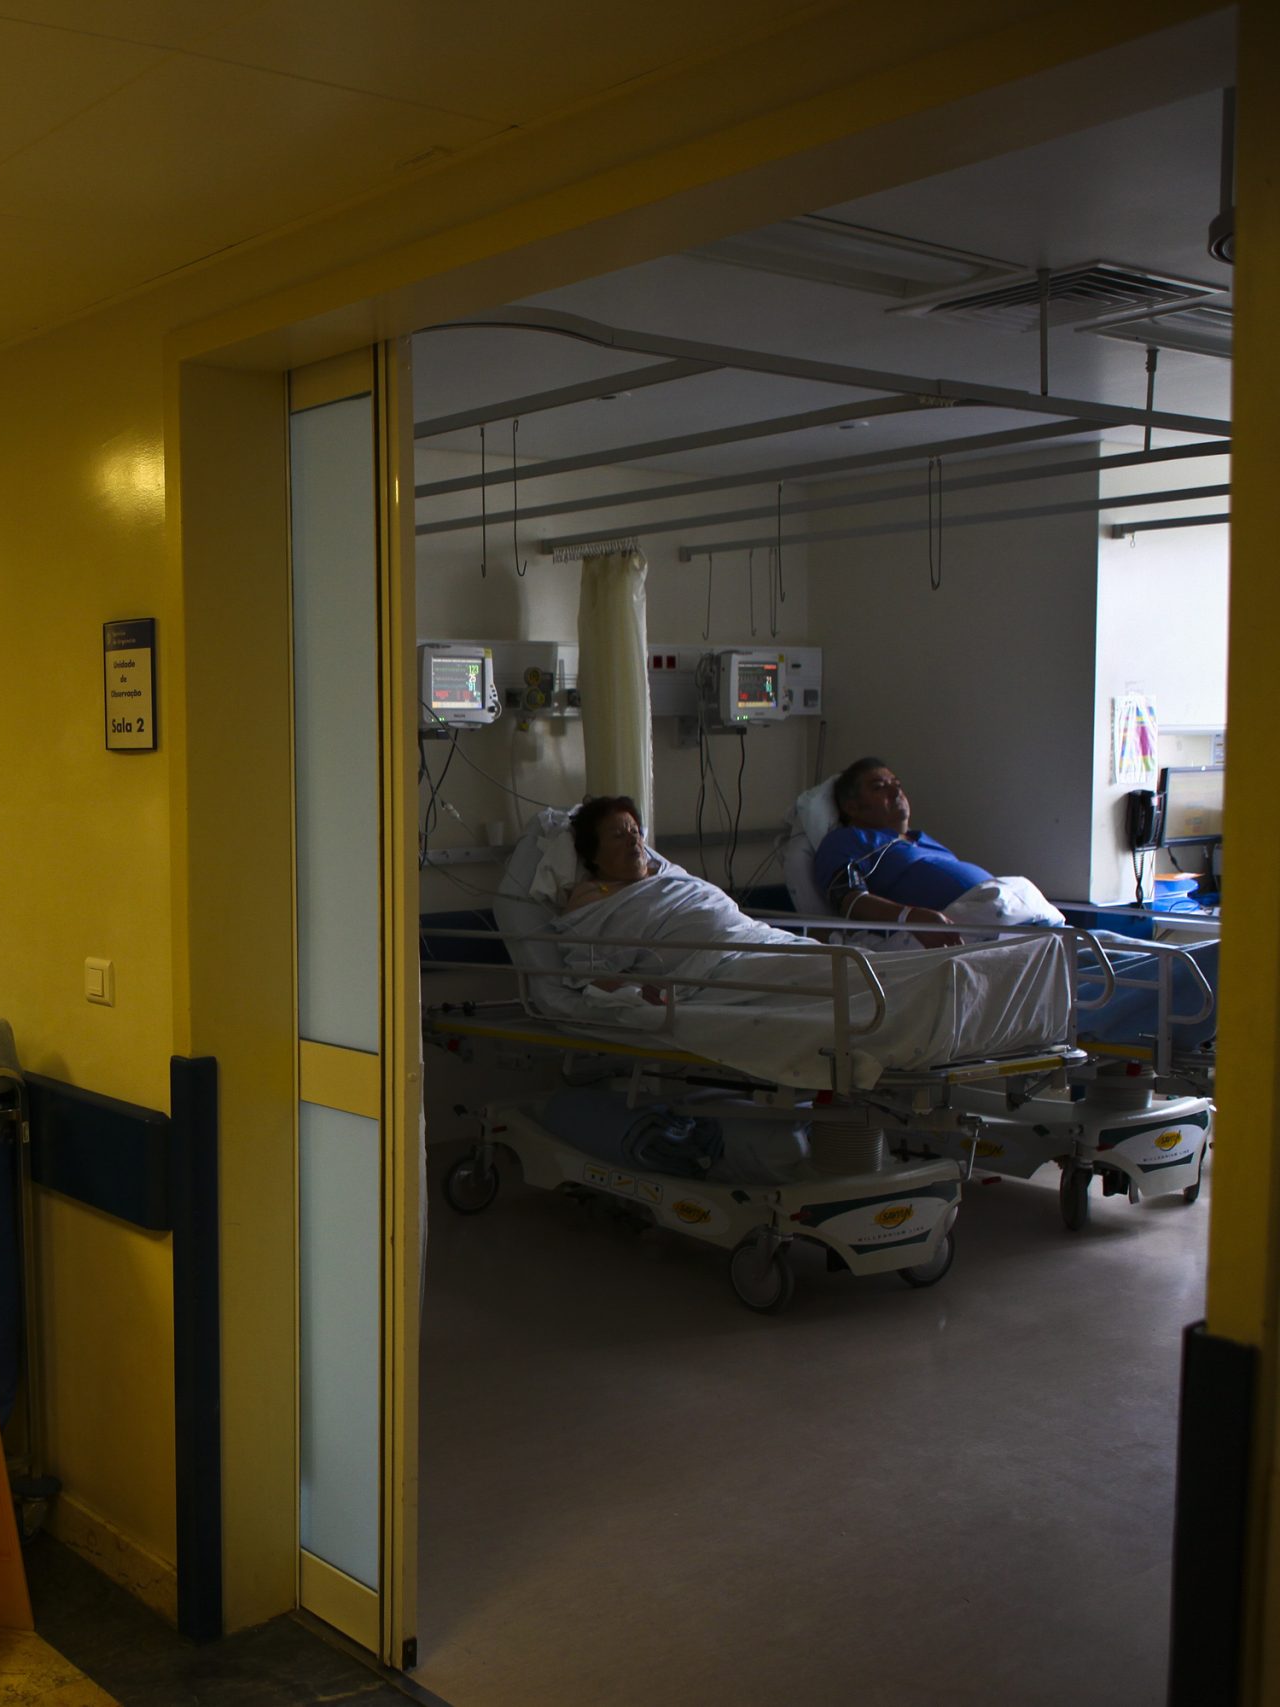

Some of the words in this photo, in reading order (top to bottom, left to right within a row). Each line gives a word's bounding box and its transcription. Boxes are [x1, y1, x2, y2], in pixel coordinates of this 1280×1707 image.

[120, 674, 128, 683] de
[111, 717, 132, 733] Sala
[136, 717, 145, 733] 2
